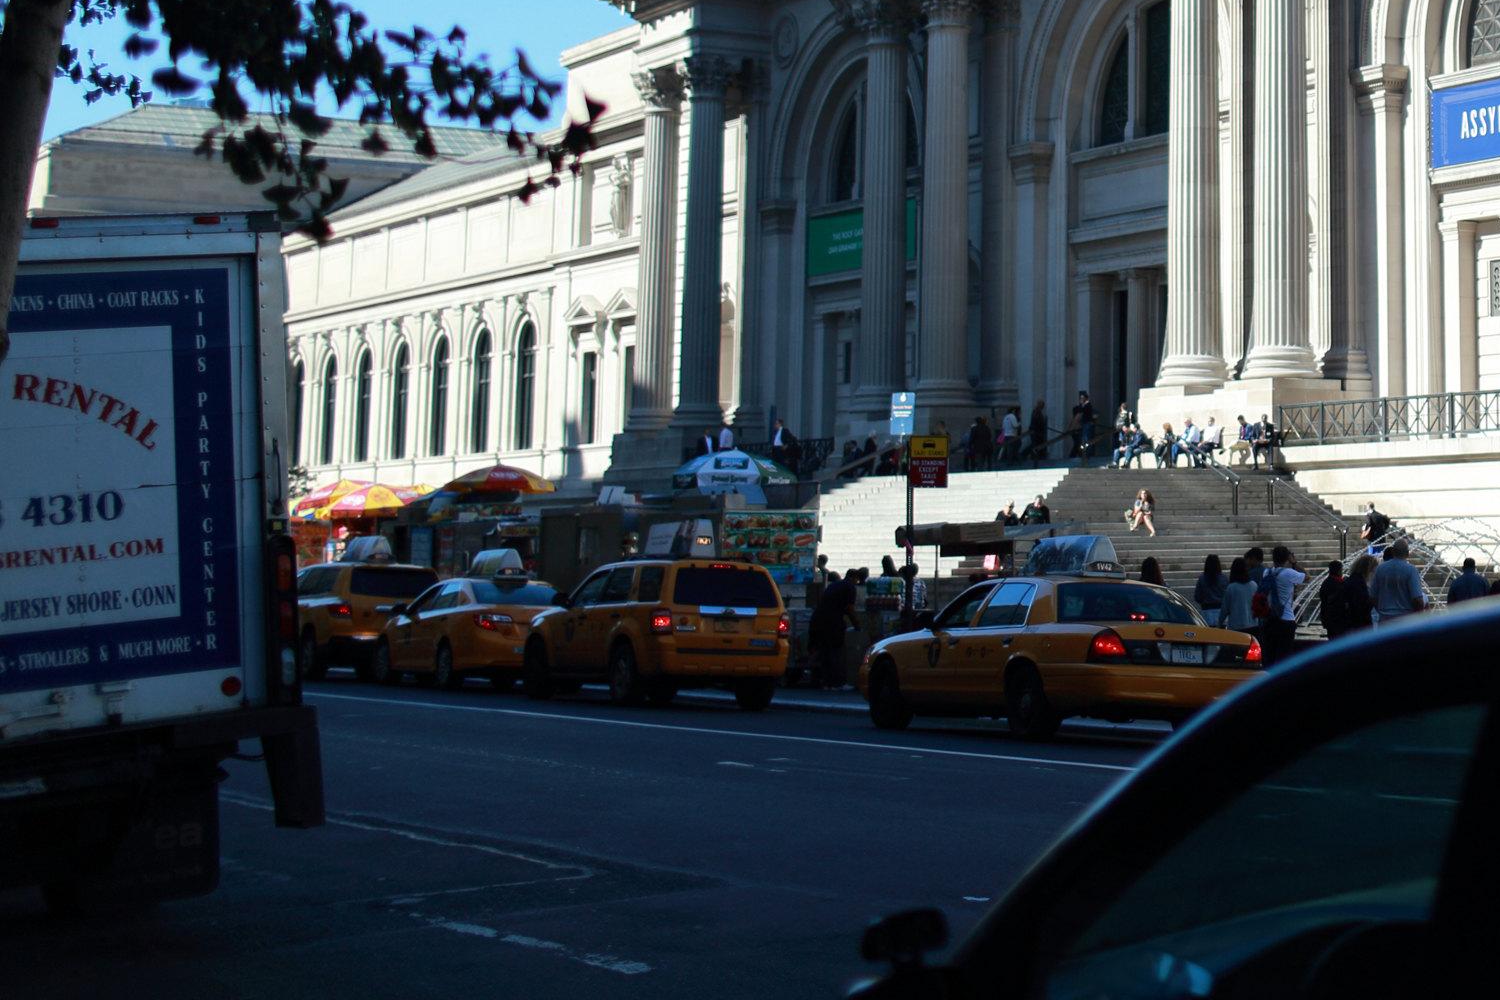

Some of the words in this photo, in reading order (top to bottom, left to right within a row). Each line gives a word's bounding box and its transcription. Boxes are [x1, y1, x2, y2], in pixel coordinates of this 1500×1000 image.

[57, 293, 95, 310] CHINA
[107, 291, 137, 309] COAT
[141, 289, 179, 307] RACKS
[194, 288, 207, 372] KIDS
[12, 373, 158, 451] RENTAL
[197, 391, 211, 499] PARTY
[21, 490, 124, 527] 4310
[1, 596, 62, 621] JERSEY
[66, 590, 122, 615] SHORE
[131, 584, 177, 608] CONN
[202, 517, 217, 650] CENTER
[18, 647, 90, 672] STROLLERS
[99, 644, 110, 662] &
[118, 640, 153, 660] MUCH
[156, 636, 191, 655] MORE
